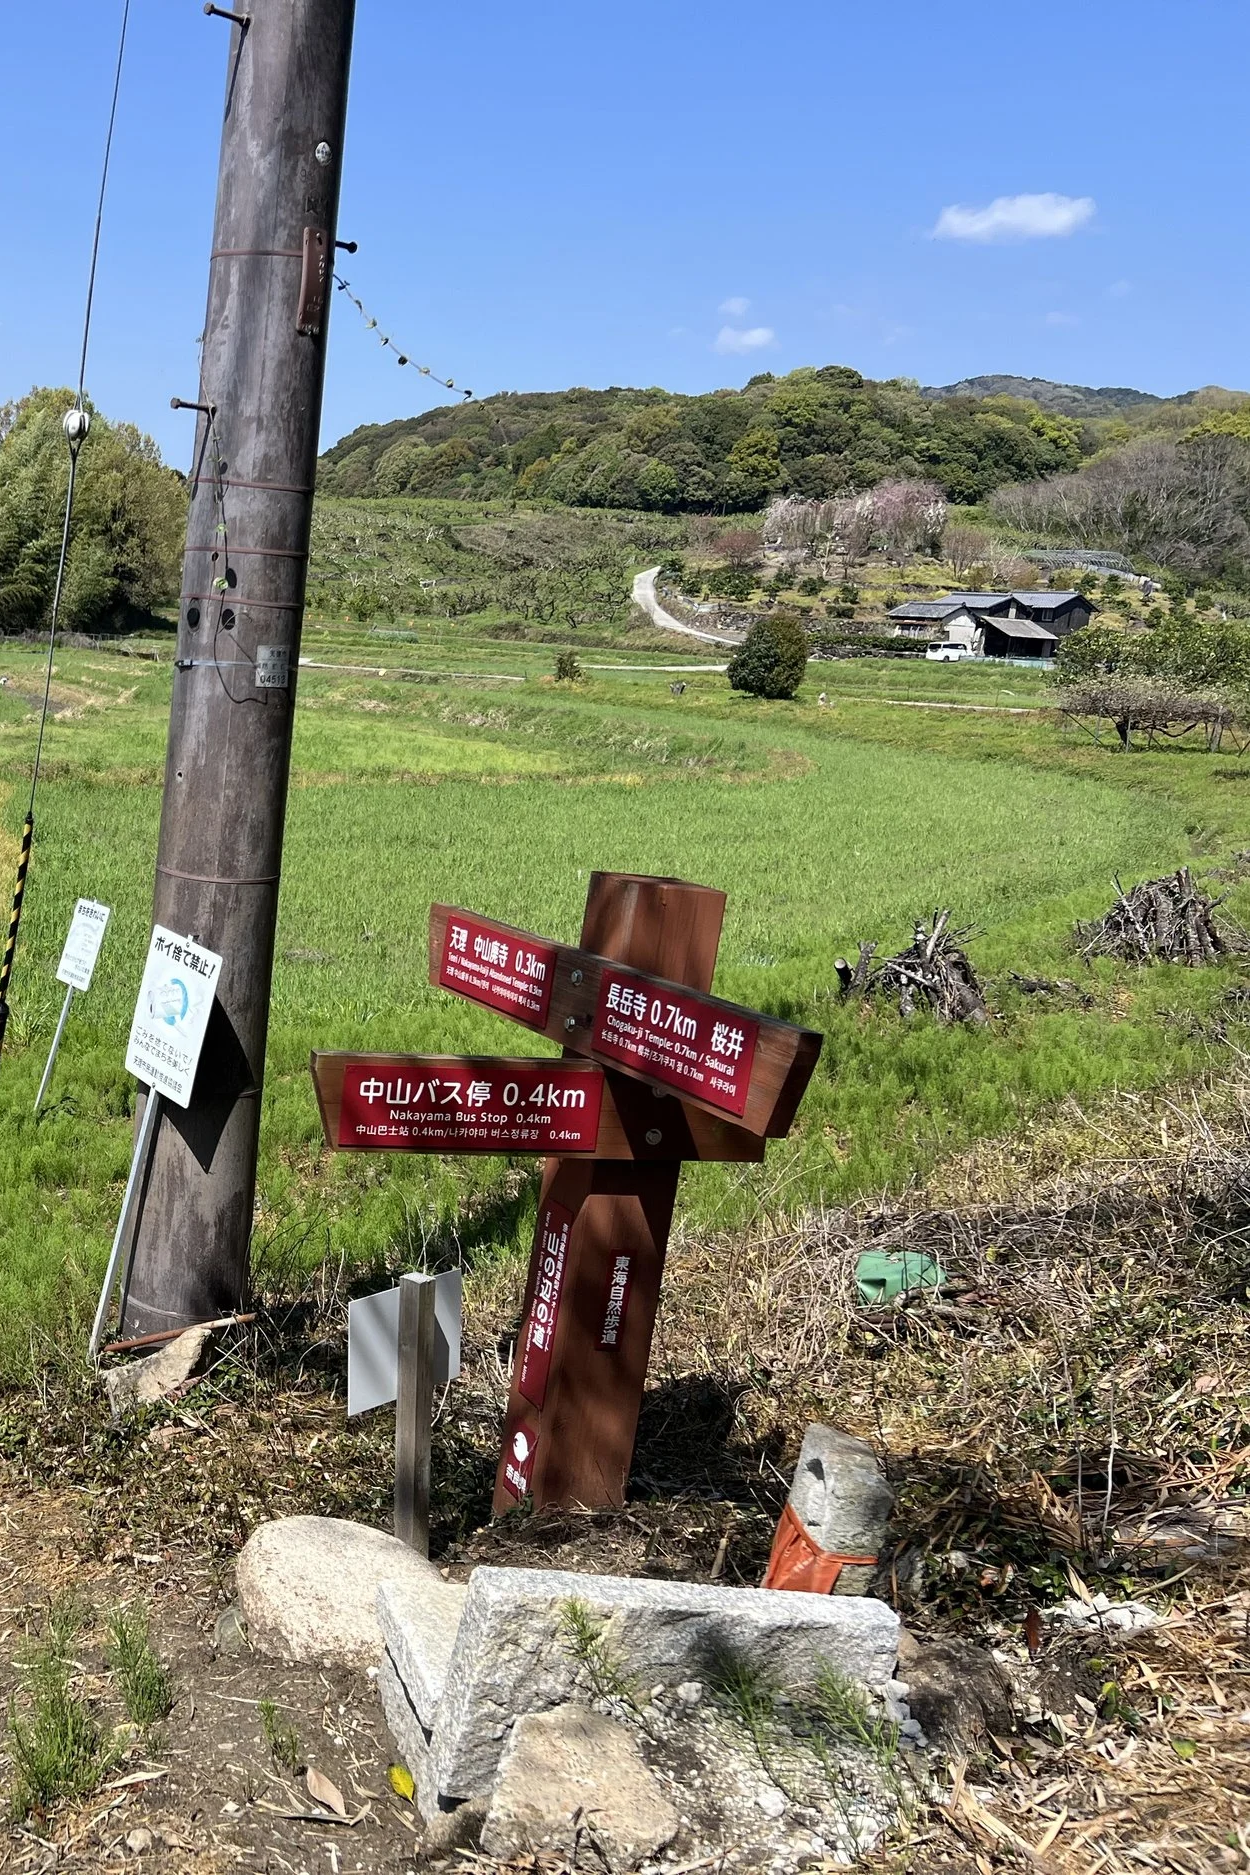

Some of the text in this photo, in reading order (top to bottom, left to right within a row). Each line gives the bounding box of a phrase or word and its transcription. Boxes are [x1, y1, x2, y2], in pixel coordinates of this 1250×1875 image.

[449, 925, 546, 981] 天理 中山廃寺 0.3km
[529, 984, 543, 997] 0.3km
[606, 983, 744, 1060] 長岳寺 0.7km 桜井
[607, 1014, 644, 1040] Chogaku-ji
[644, 1030, 673, 1051] Temple:
[674, 1042, 697, 1061] 0.7km
[704, 1055, 735, 1077] Sakurai
[359, 1077, 586, 1108] 中山バス停 0.4km
[618, 1036, 637, 1053] 0.7km
[676, 1062, 683, 1074] 절
[683, 1064, 704, 1083] 0.7km
[709, 1076, 736, 1097] 사쿠라이
[355, 1125, 581, 1140] 中山巴士站 0.4km/나카야마 버스정류장 0.4km
[389, 1110, 551, 1125] Nakayama Bus Stop 0.4km
[532, 1233, 559, 1349] 山の辺の道
[601, 1256, 630, 1344] 東海自然歩道
